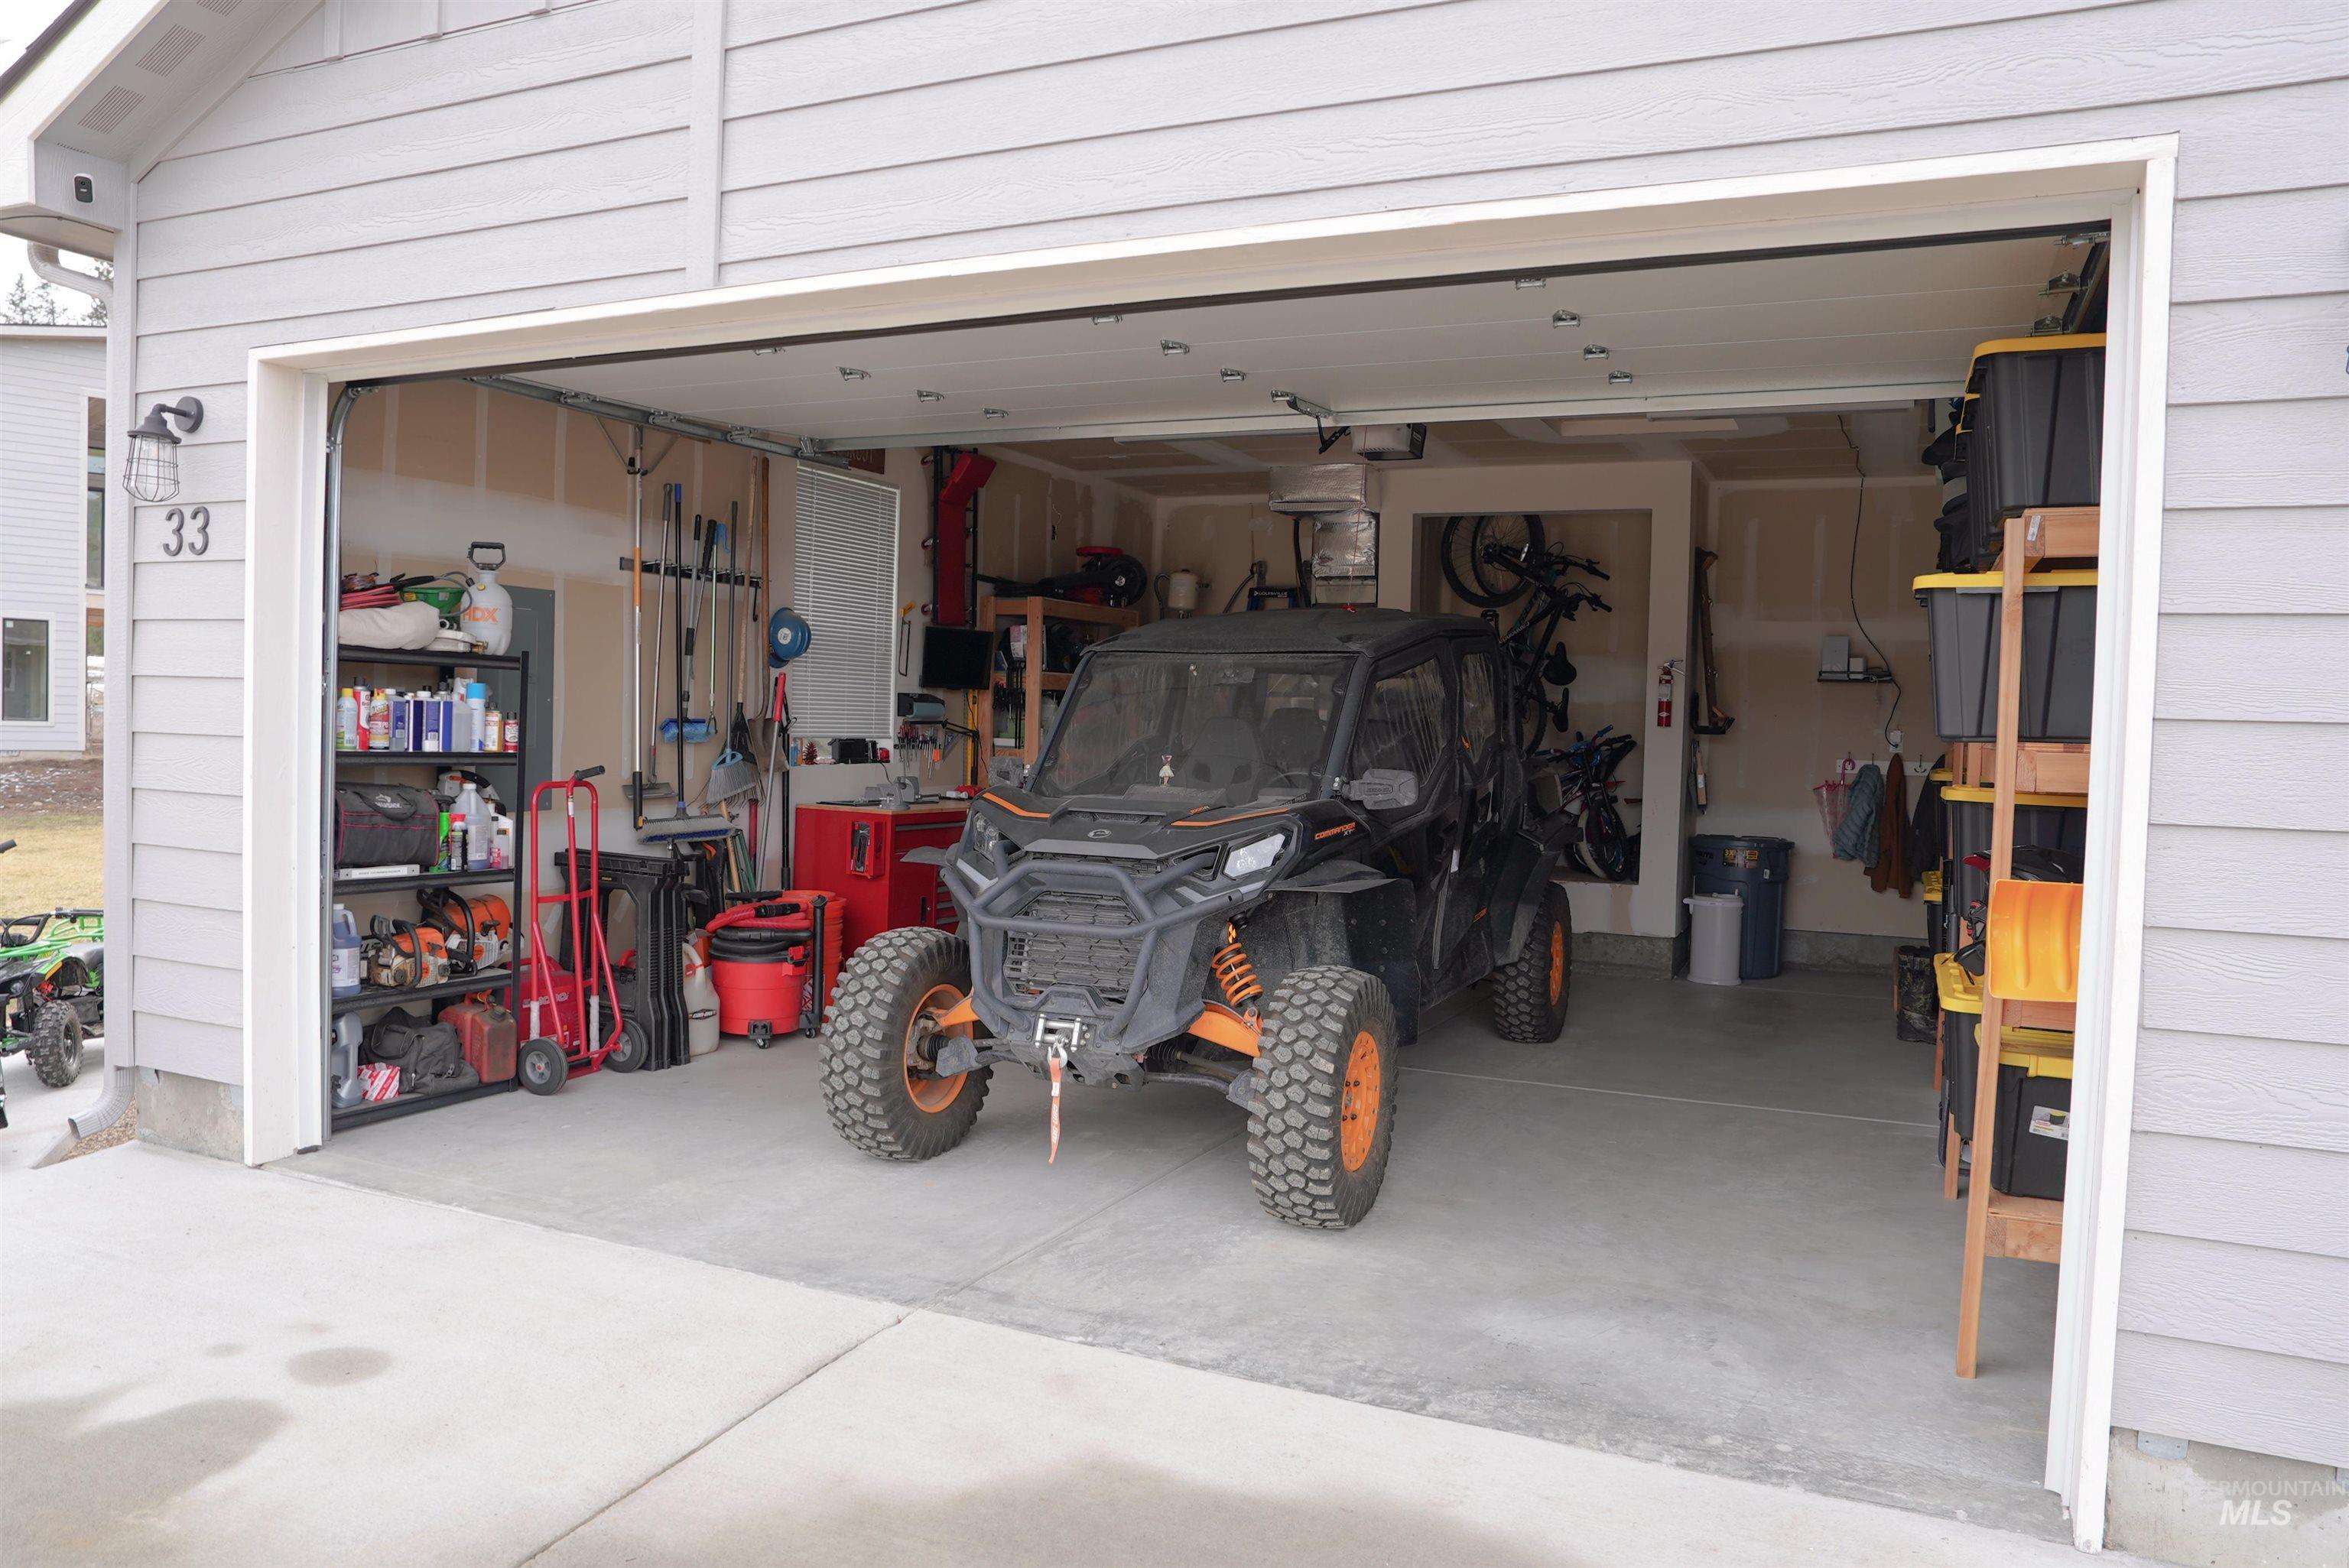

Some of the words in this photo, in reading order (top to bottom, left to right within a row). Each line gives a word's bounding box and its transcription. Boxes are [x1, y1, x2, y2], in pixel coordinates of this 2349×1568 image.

[162, 506, 210, 557] 33
[463, 605, 499, 624] HDX
[1314, 822, 1356, 840] COMMANDER
